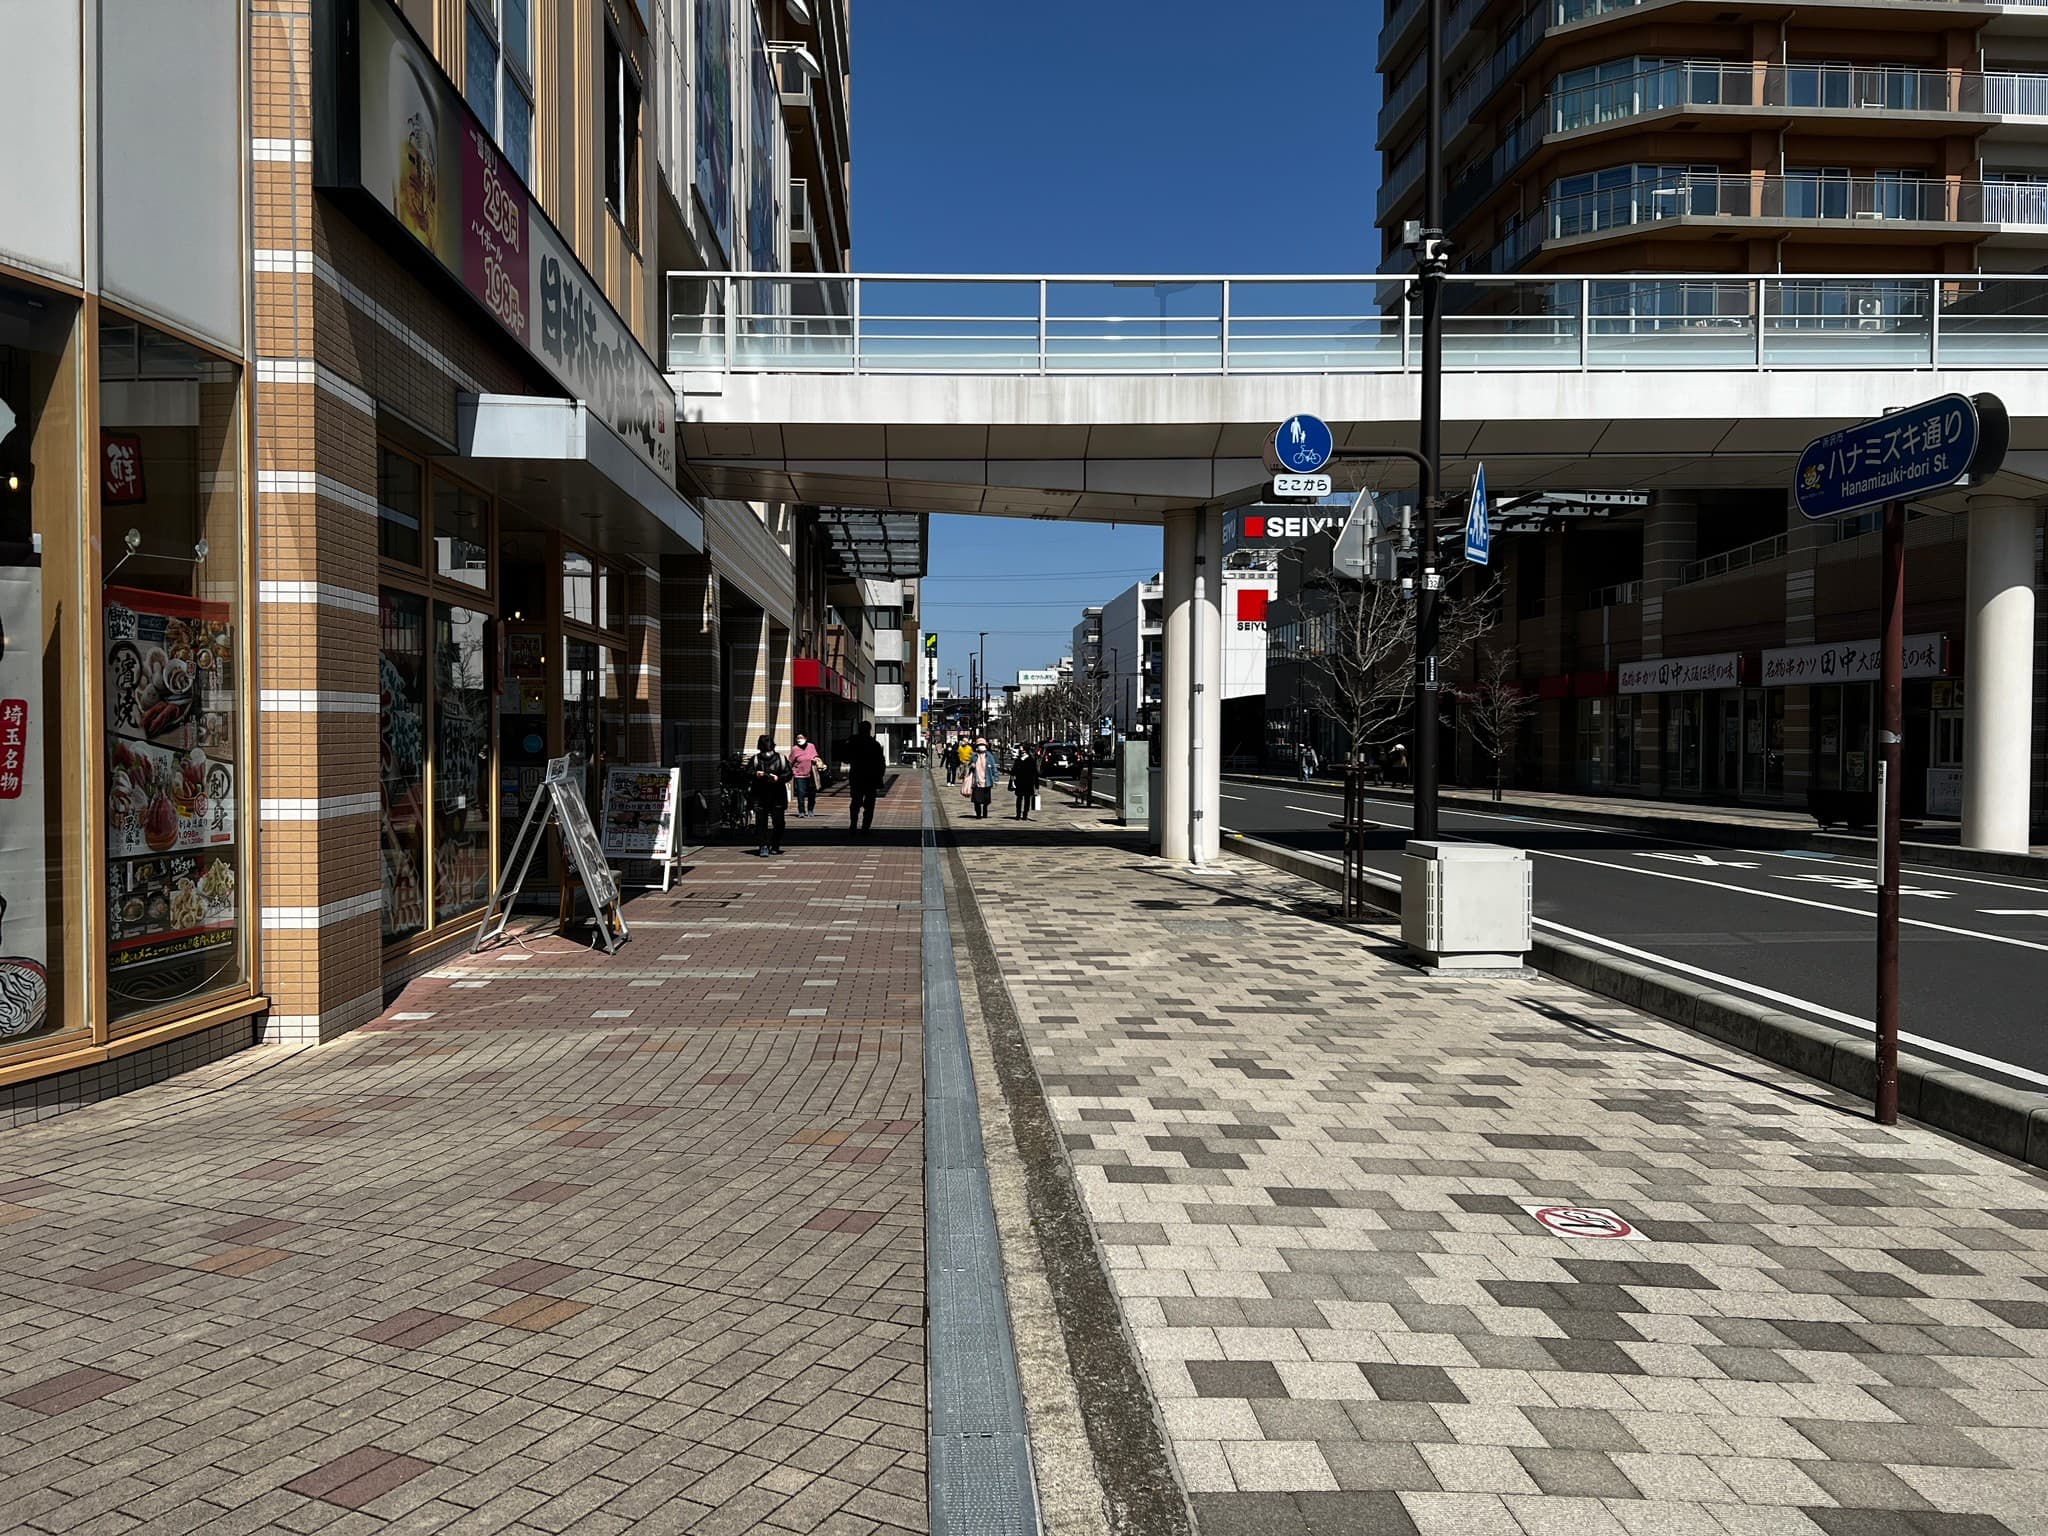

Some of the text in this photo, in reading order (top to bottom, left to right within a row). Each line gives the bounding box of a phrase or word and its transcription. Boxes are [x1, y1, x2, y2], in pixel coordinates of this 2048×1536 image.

[483, 167, 519, 253] 298円
[471, 219, 503, 262] ハイボール
[1822, 432, 1844, 448] 所沢市
[1829, 410, 1962, 480] ハナミズキ通り
[107, 443, 136, 495] 鮮
[1278, 479, 1328, 492] ここから
[1841, 453, 1949, 497] Hanamizuki-dori St.
[1, 705, 23, 791] 埼玉名物
[208, 773, 229, 832] 刺身
